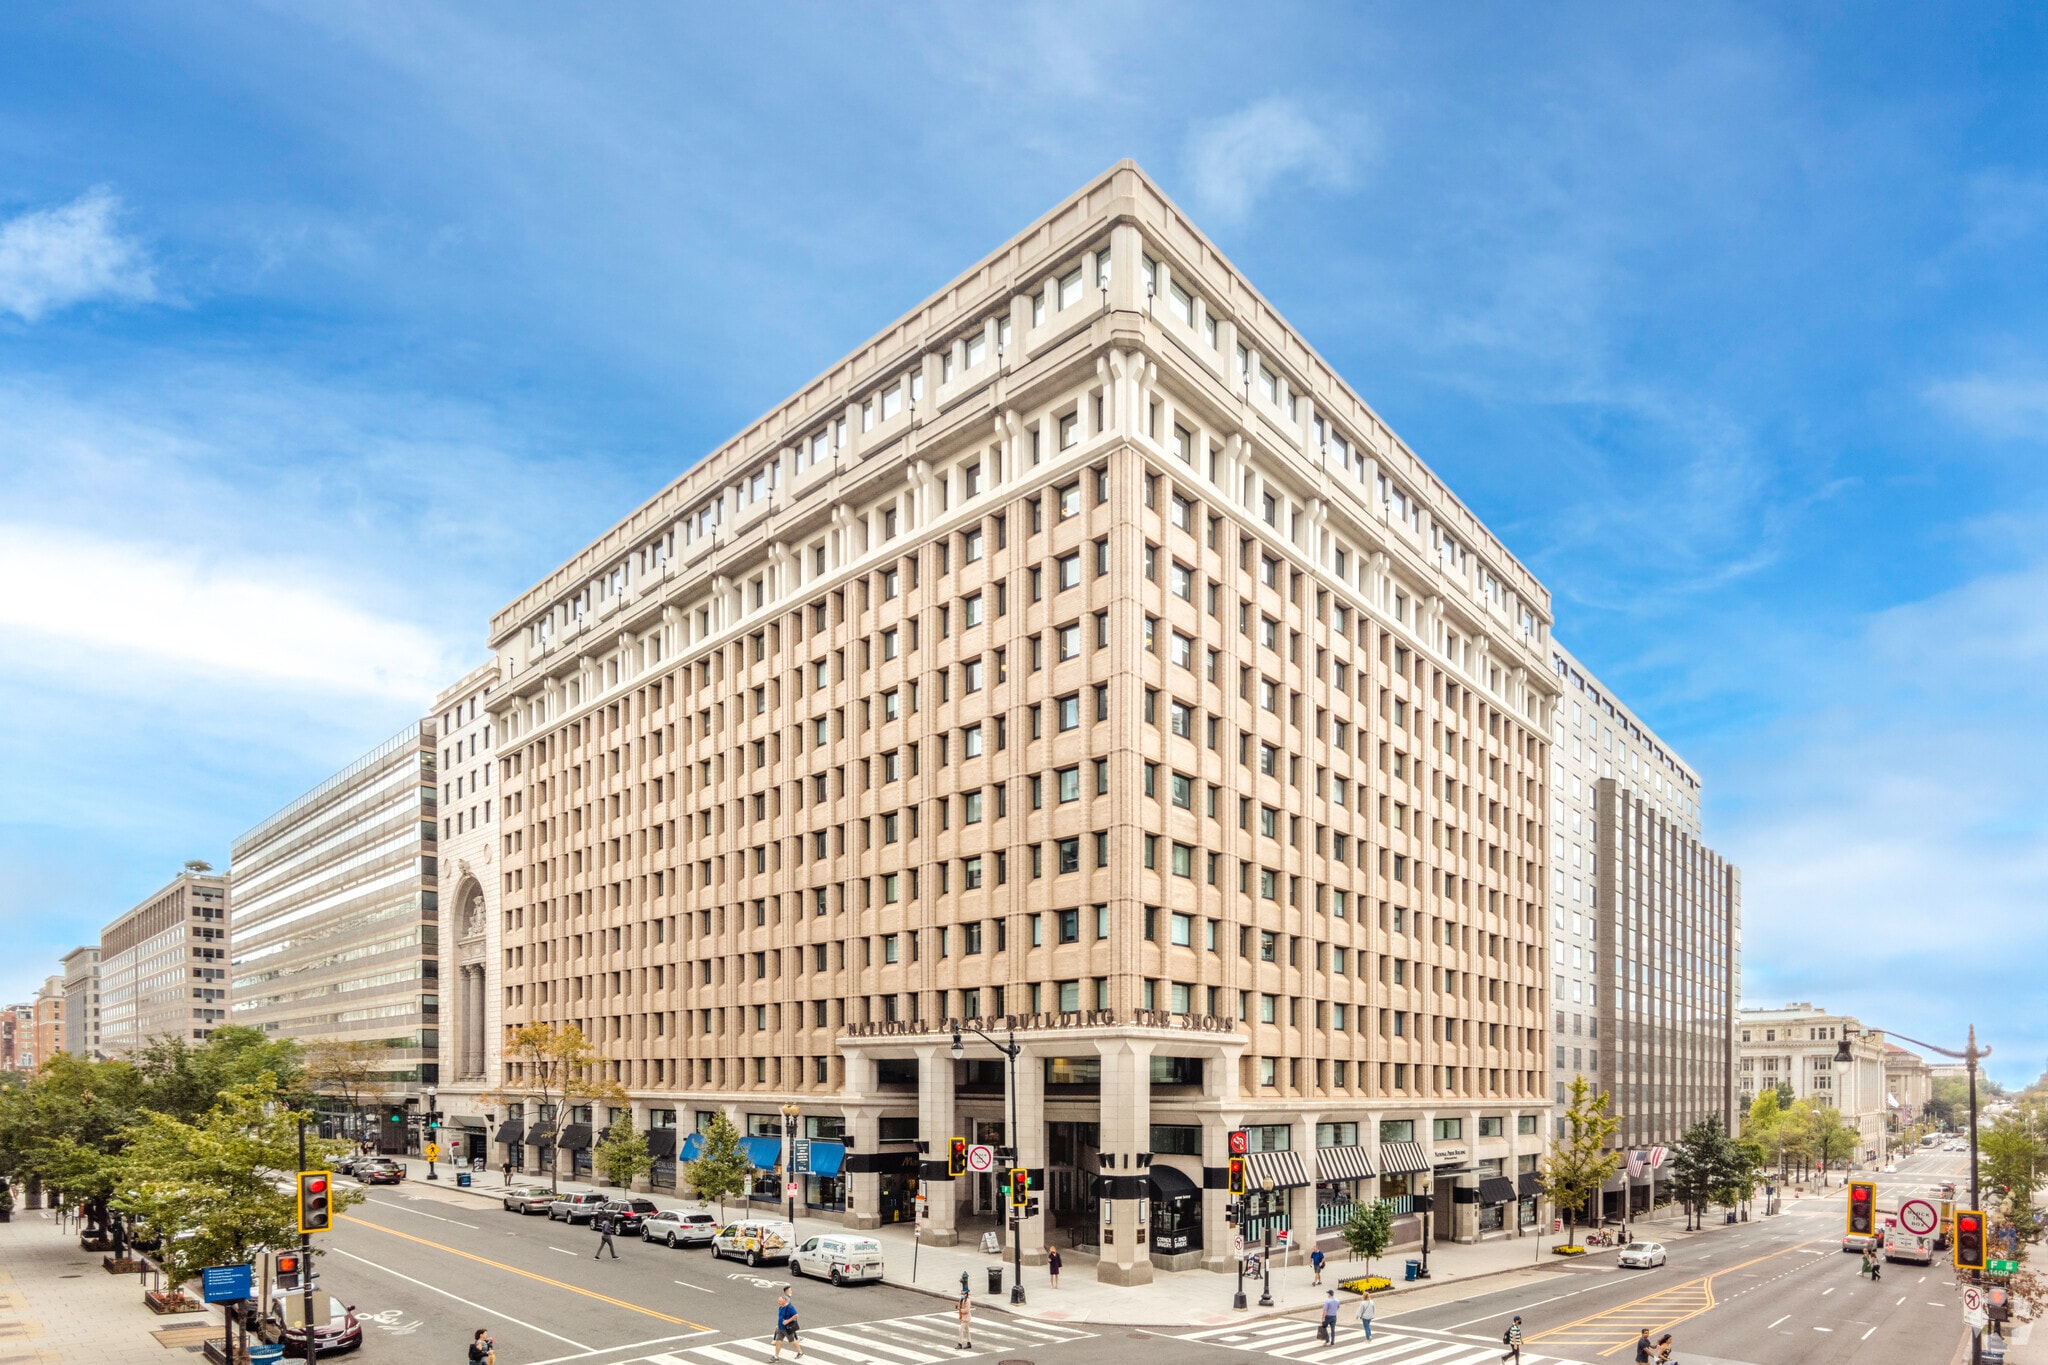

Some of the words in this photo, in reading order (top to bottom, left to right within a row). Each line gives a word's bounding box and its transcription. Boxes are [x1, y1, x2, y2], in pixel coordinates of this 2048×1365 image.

[848, 1019, 929, 1036] NATIONAL
[938, 1015, 996, 1034] PRESS
[1006, 1008, 1114, 1029] BUILDING
[1134, 1008, 1170, 1028] THE
[1182, 1012, 1233, 1033] SHOPS
[1990, 1260, 1998, 1269] F
